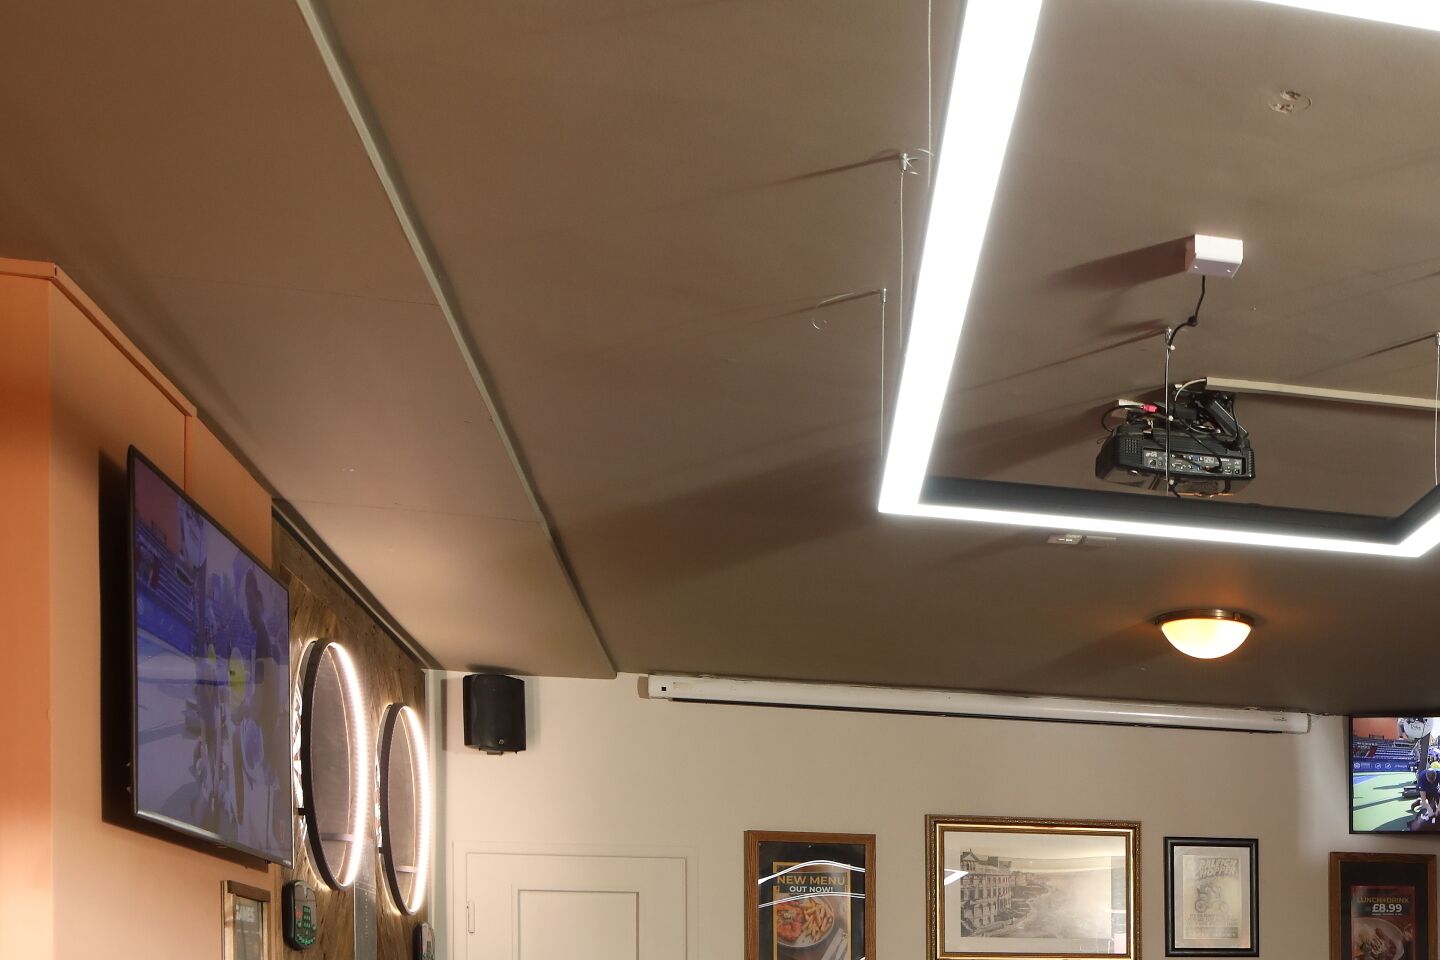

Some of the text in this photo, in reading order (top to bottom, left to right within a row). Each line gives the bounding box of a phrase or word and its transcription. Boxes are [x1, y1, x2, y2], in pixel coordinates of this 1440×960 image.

[777, 875, 845, 885] NEW MENU
[1371, 903, 1402, 912] £8.99
